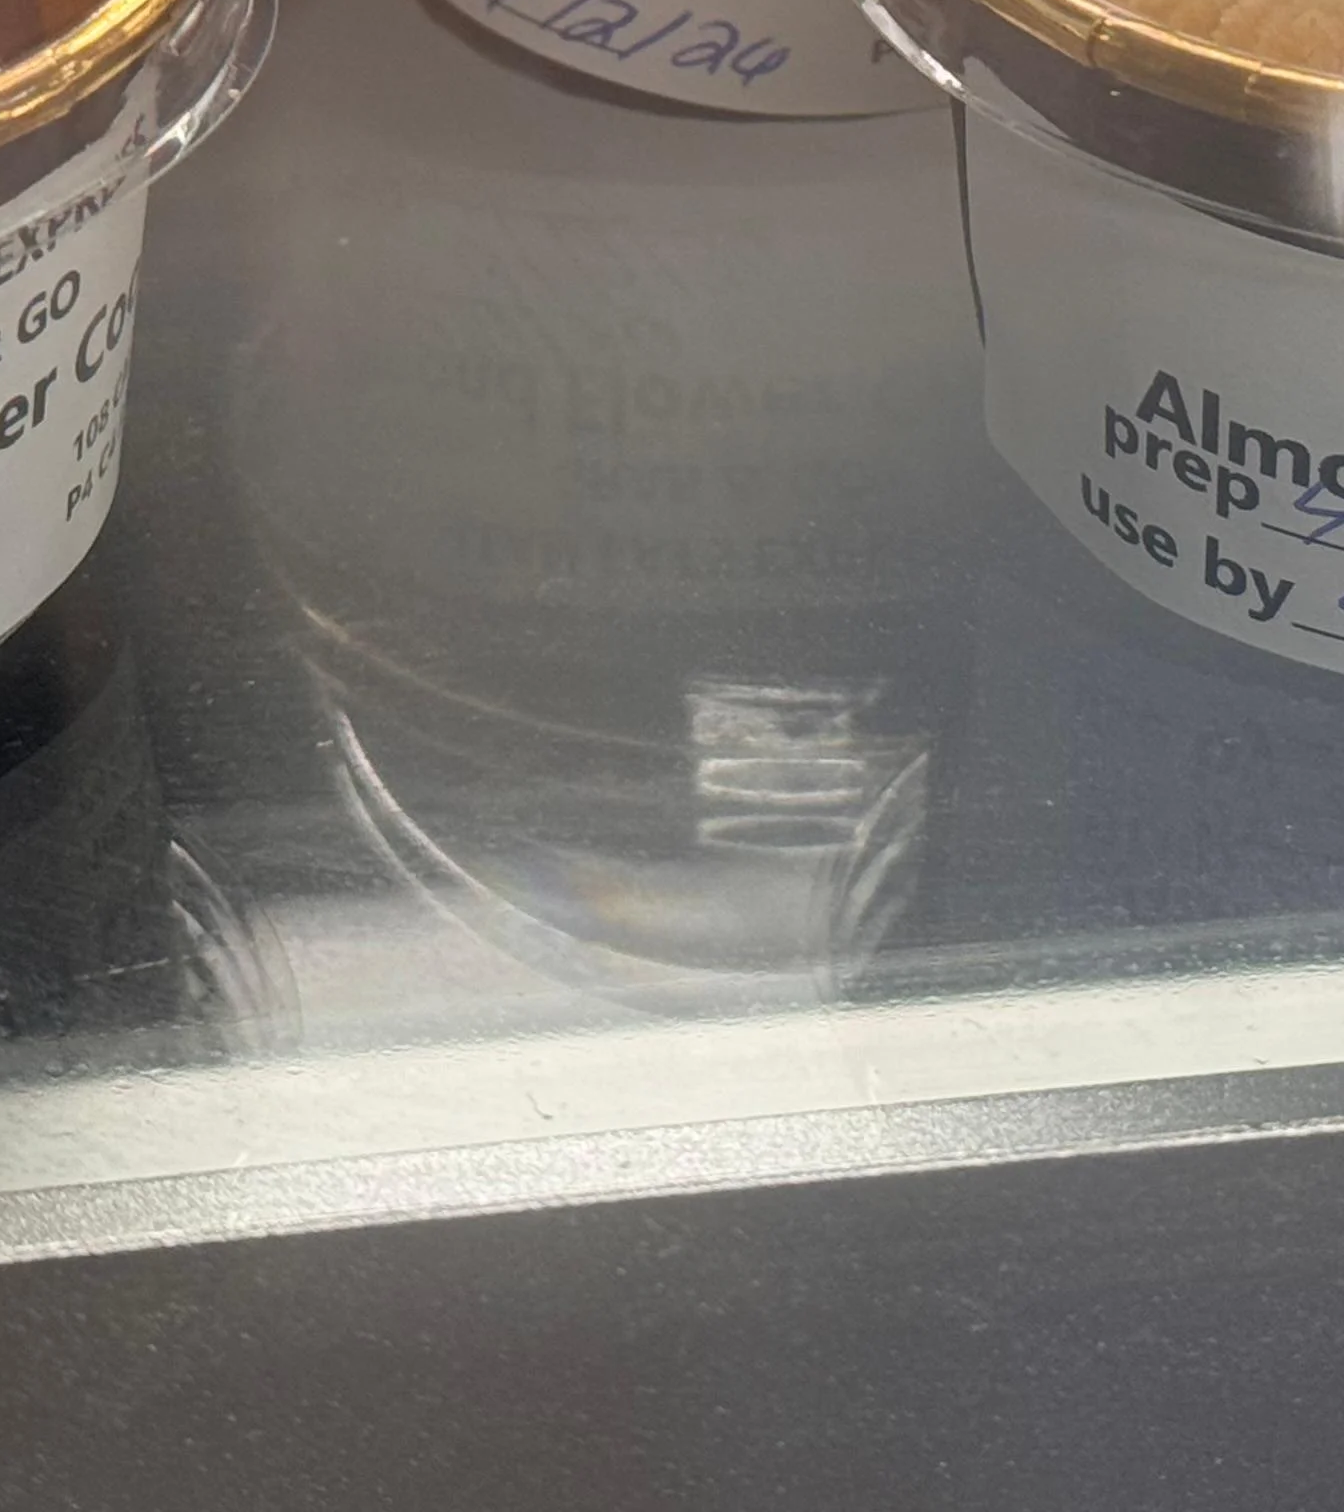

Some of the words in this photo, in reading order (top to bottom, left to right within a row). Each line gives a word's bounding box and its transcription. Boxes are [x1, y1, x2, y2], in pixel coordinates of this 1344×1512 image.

[17, 270, 81, 344] GO
[73, 398, 110, 462] 108
[1104, 404, 1260, 517] prep
[1080, 473, 1179, 567] use
[1204, 536, 1296, 621] by
